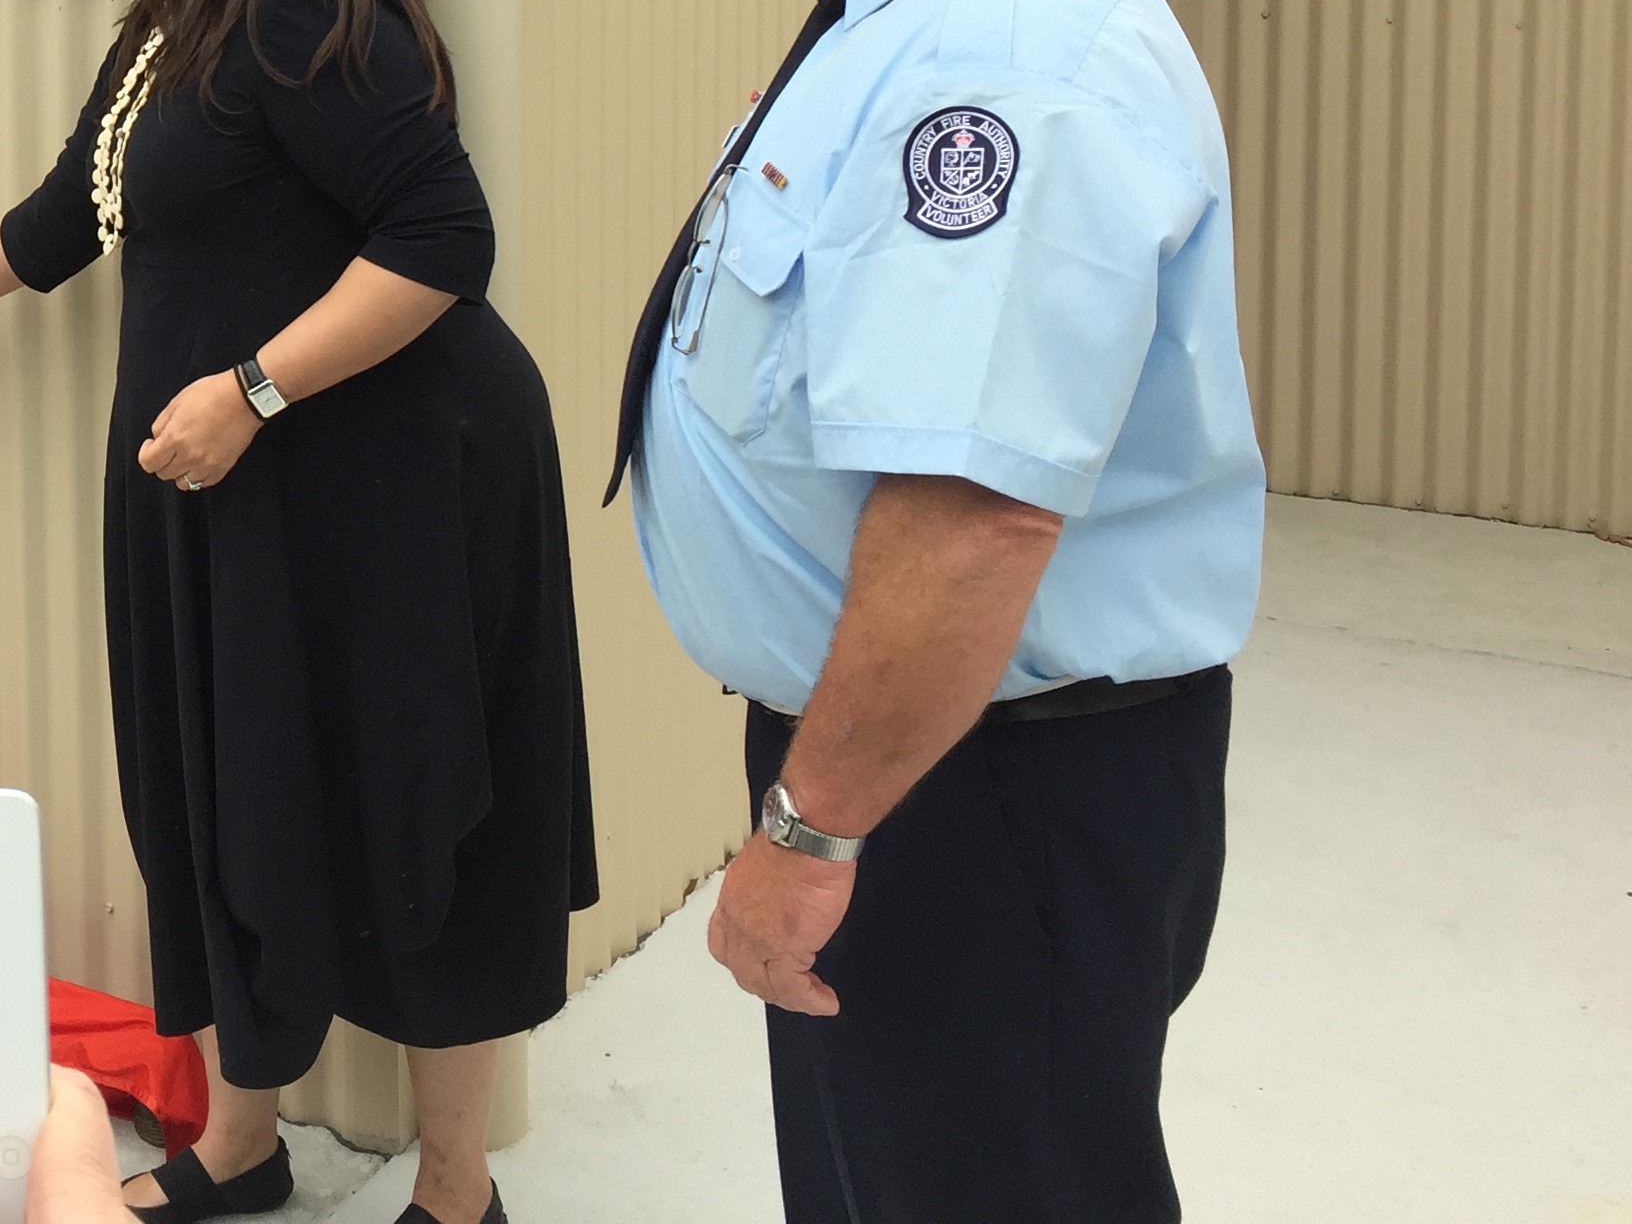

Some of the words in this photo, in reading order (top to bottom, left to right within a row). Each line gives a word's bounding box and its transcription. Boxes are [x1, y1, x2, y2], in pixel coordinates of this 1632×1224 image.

[913, 126, 937, 180] COUNTRY
[940, 115, 971, 129] FIRE
[978, 120, 1011, 179] AUTHORITY
[930, 190, 989, 210] VICTORIA
[925, 205, 992, 226] VOLUNTEER
